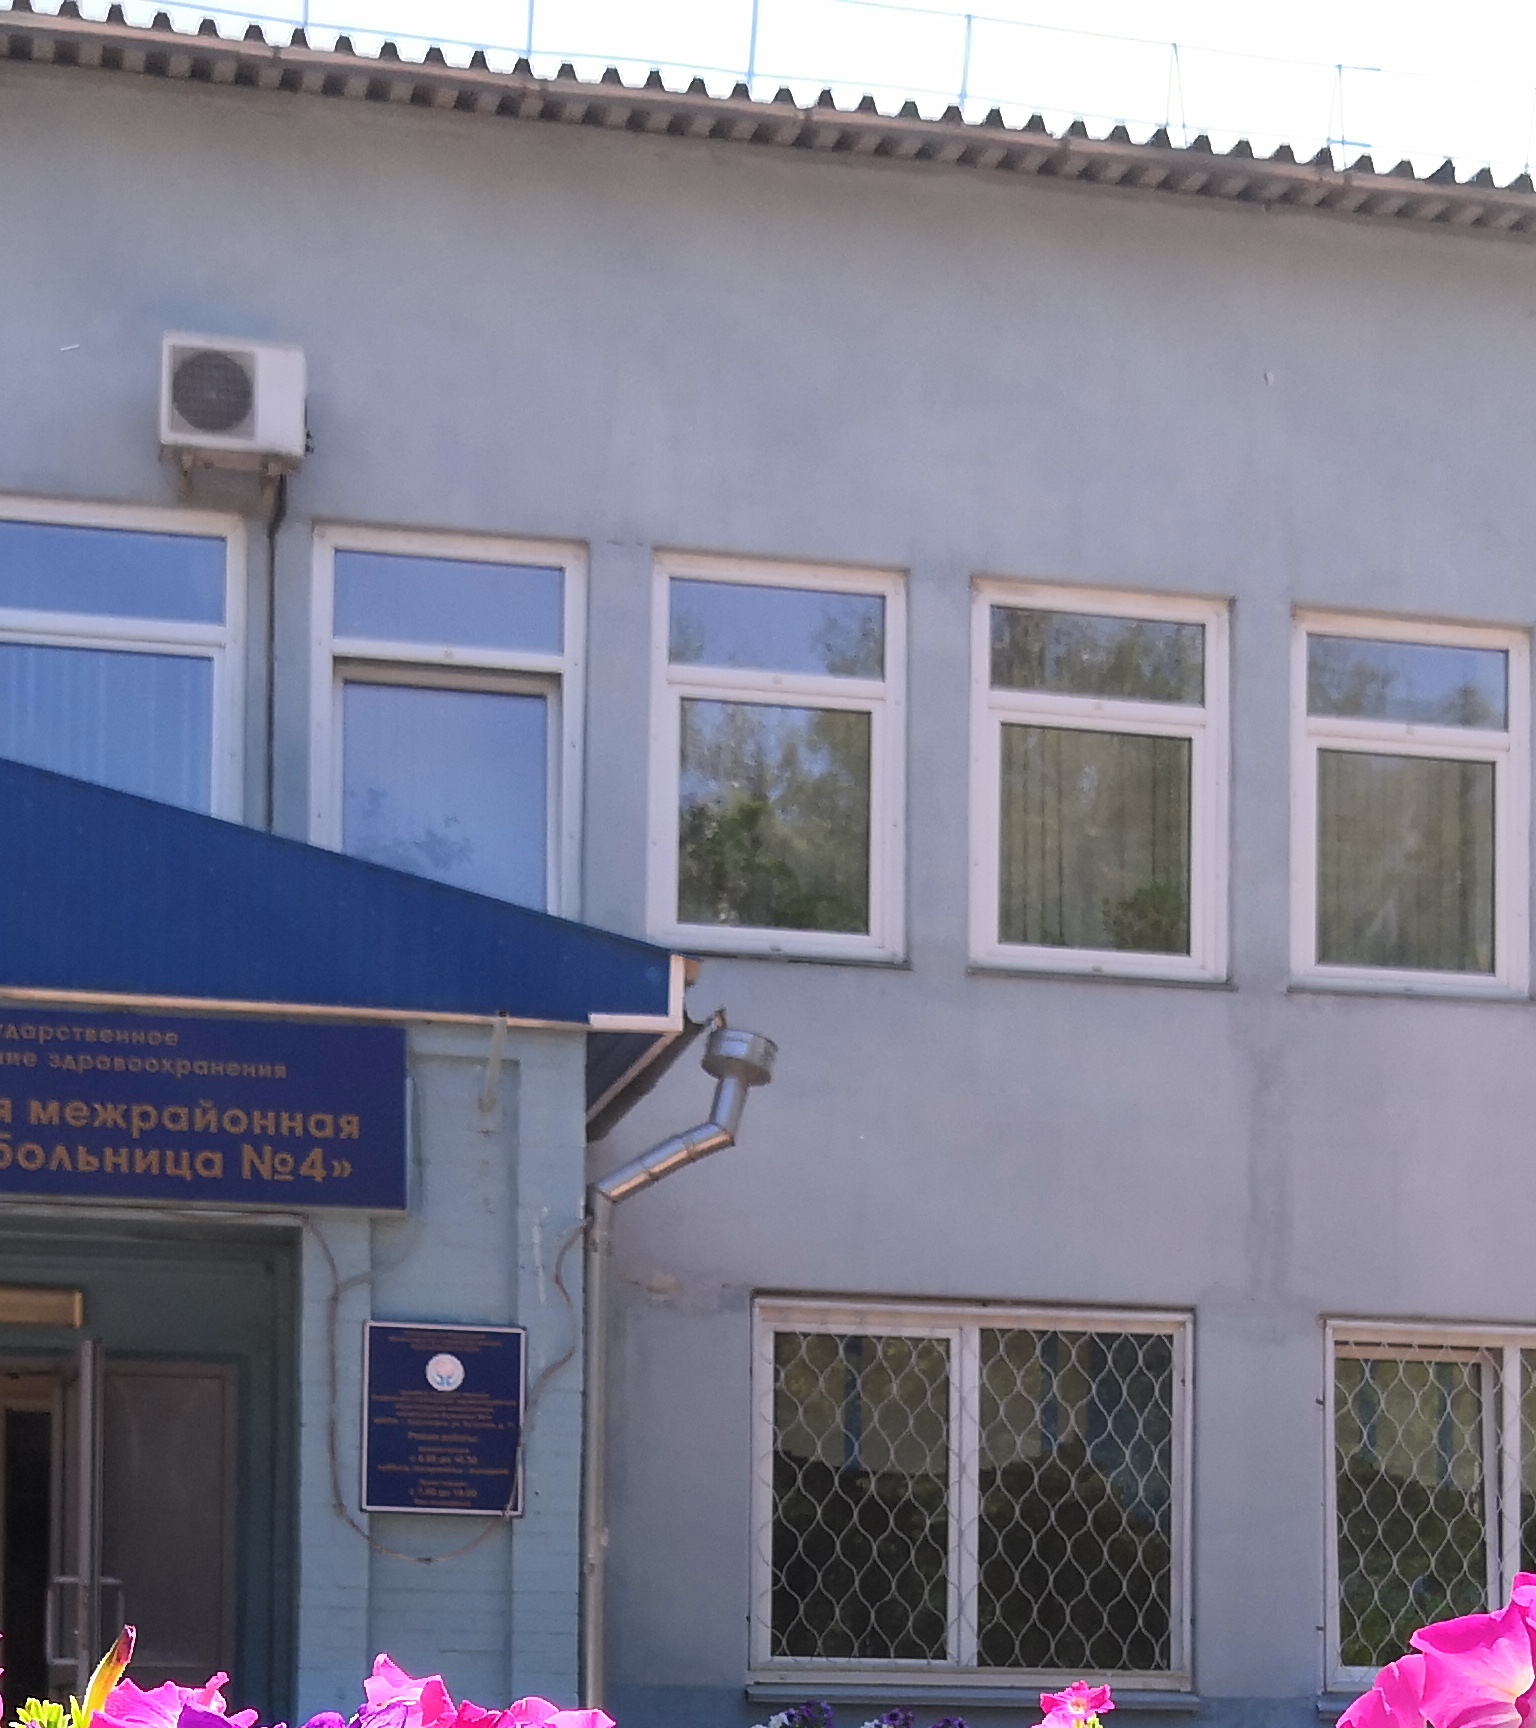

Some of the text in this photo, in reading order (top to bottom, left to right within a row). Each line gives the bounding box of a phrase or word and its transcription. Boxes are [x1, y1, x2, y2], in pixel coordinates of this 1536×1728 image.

[49, 1051, 288, 1079] здравоохранения
[29, 1098, 361, 1140] межрайонная
[241, 1142, 353, 1182] №4»
